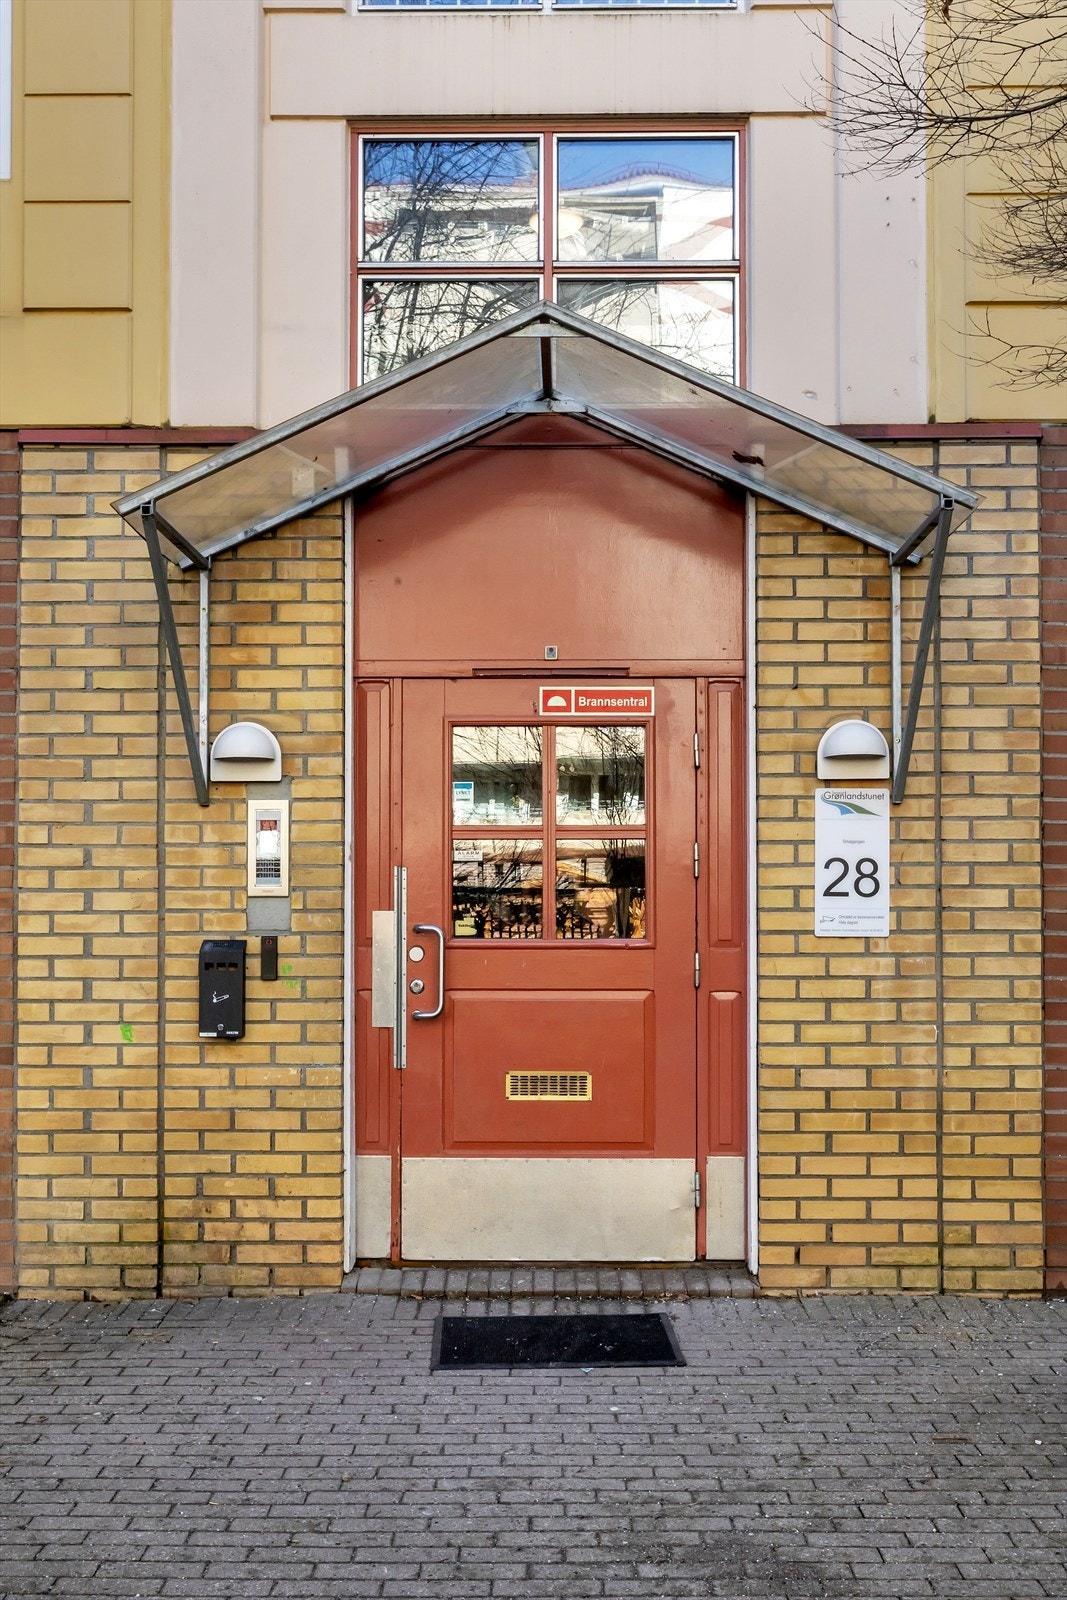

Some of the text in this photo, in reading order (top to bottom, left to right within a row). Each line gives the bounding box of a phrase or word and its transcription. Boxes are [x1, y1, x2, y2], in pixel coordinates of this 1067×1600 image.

[578, 696, 648, 707] Brannsentral
[823, 790, 885, 801] Grønlandstunet
[822, 857, 880, 898] 28
